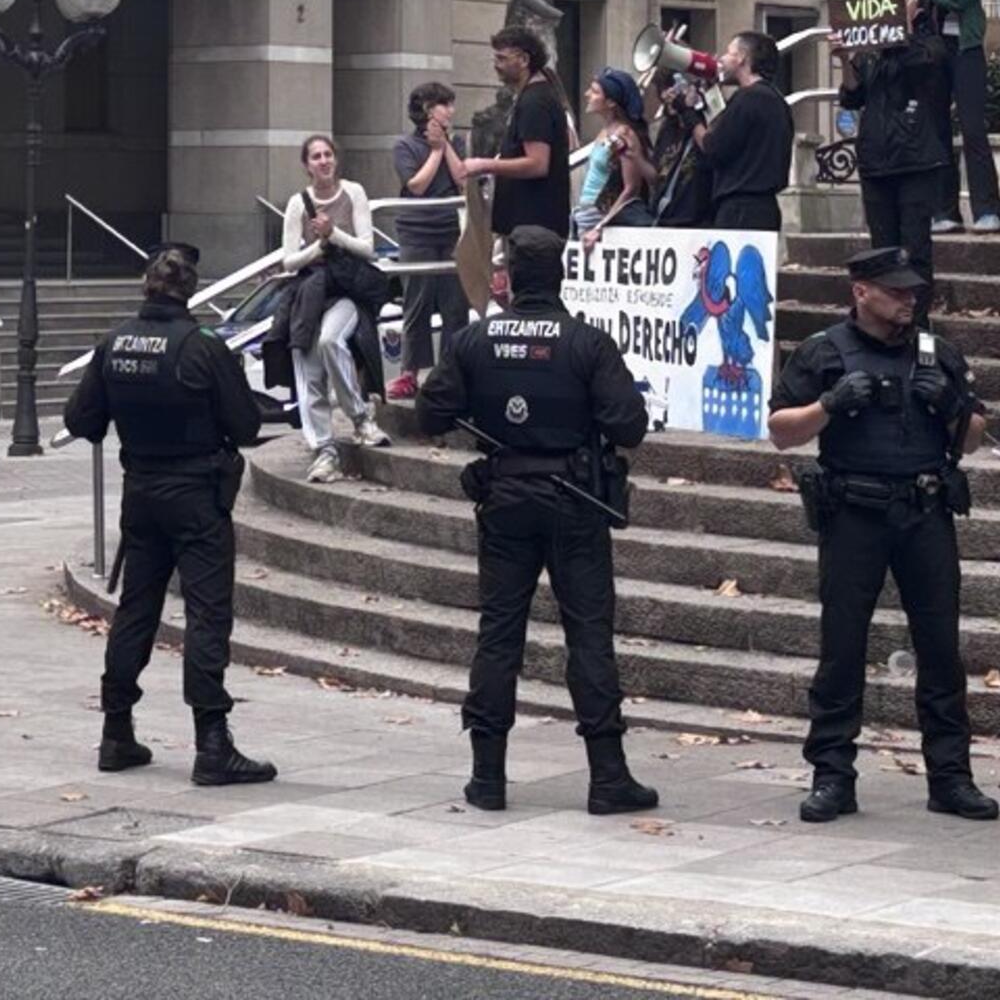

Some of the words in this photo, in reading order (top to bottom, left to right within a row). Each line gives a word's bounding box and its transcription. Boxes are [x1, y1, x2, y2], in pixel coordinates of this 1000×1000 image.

[566, 248, 595, 283] EL
[602, 246, 677, 286] TECHO
[618, 310, 698, 367] DERECHO
